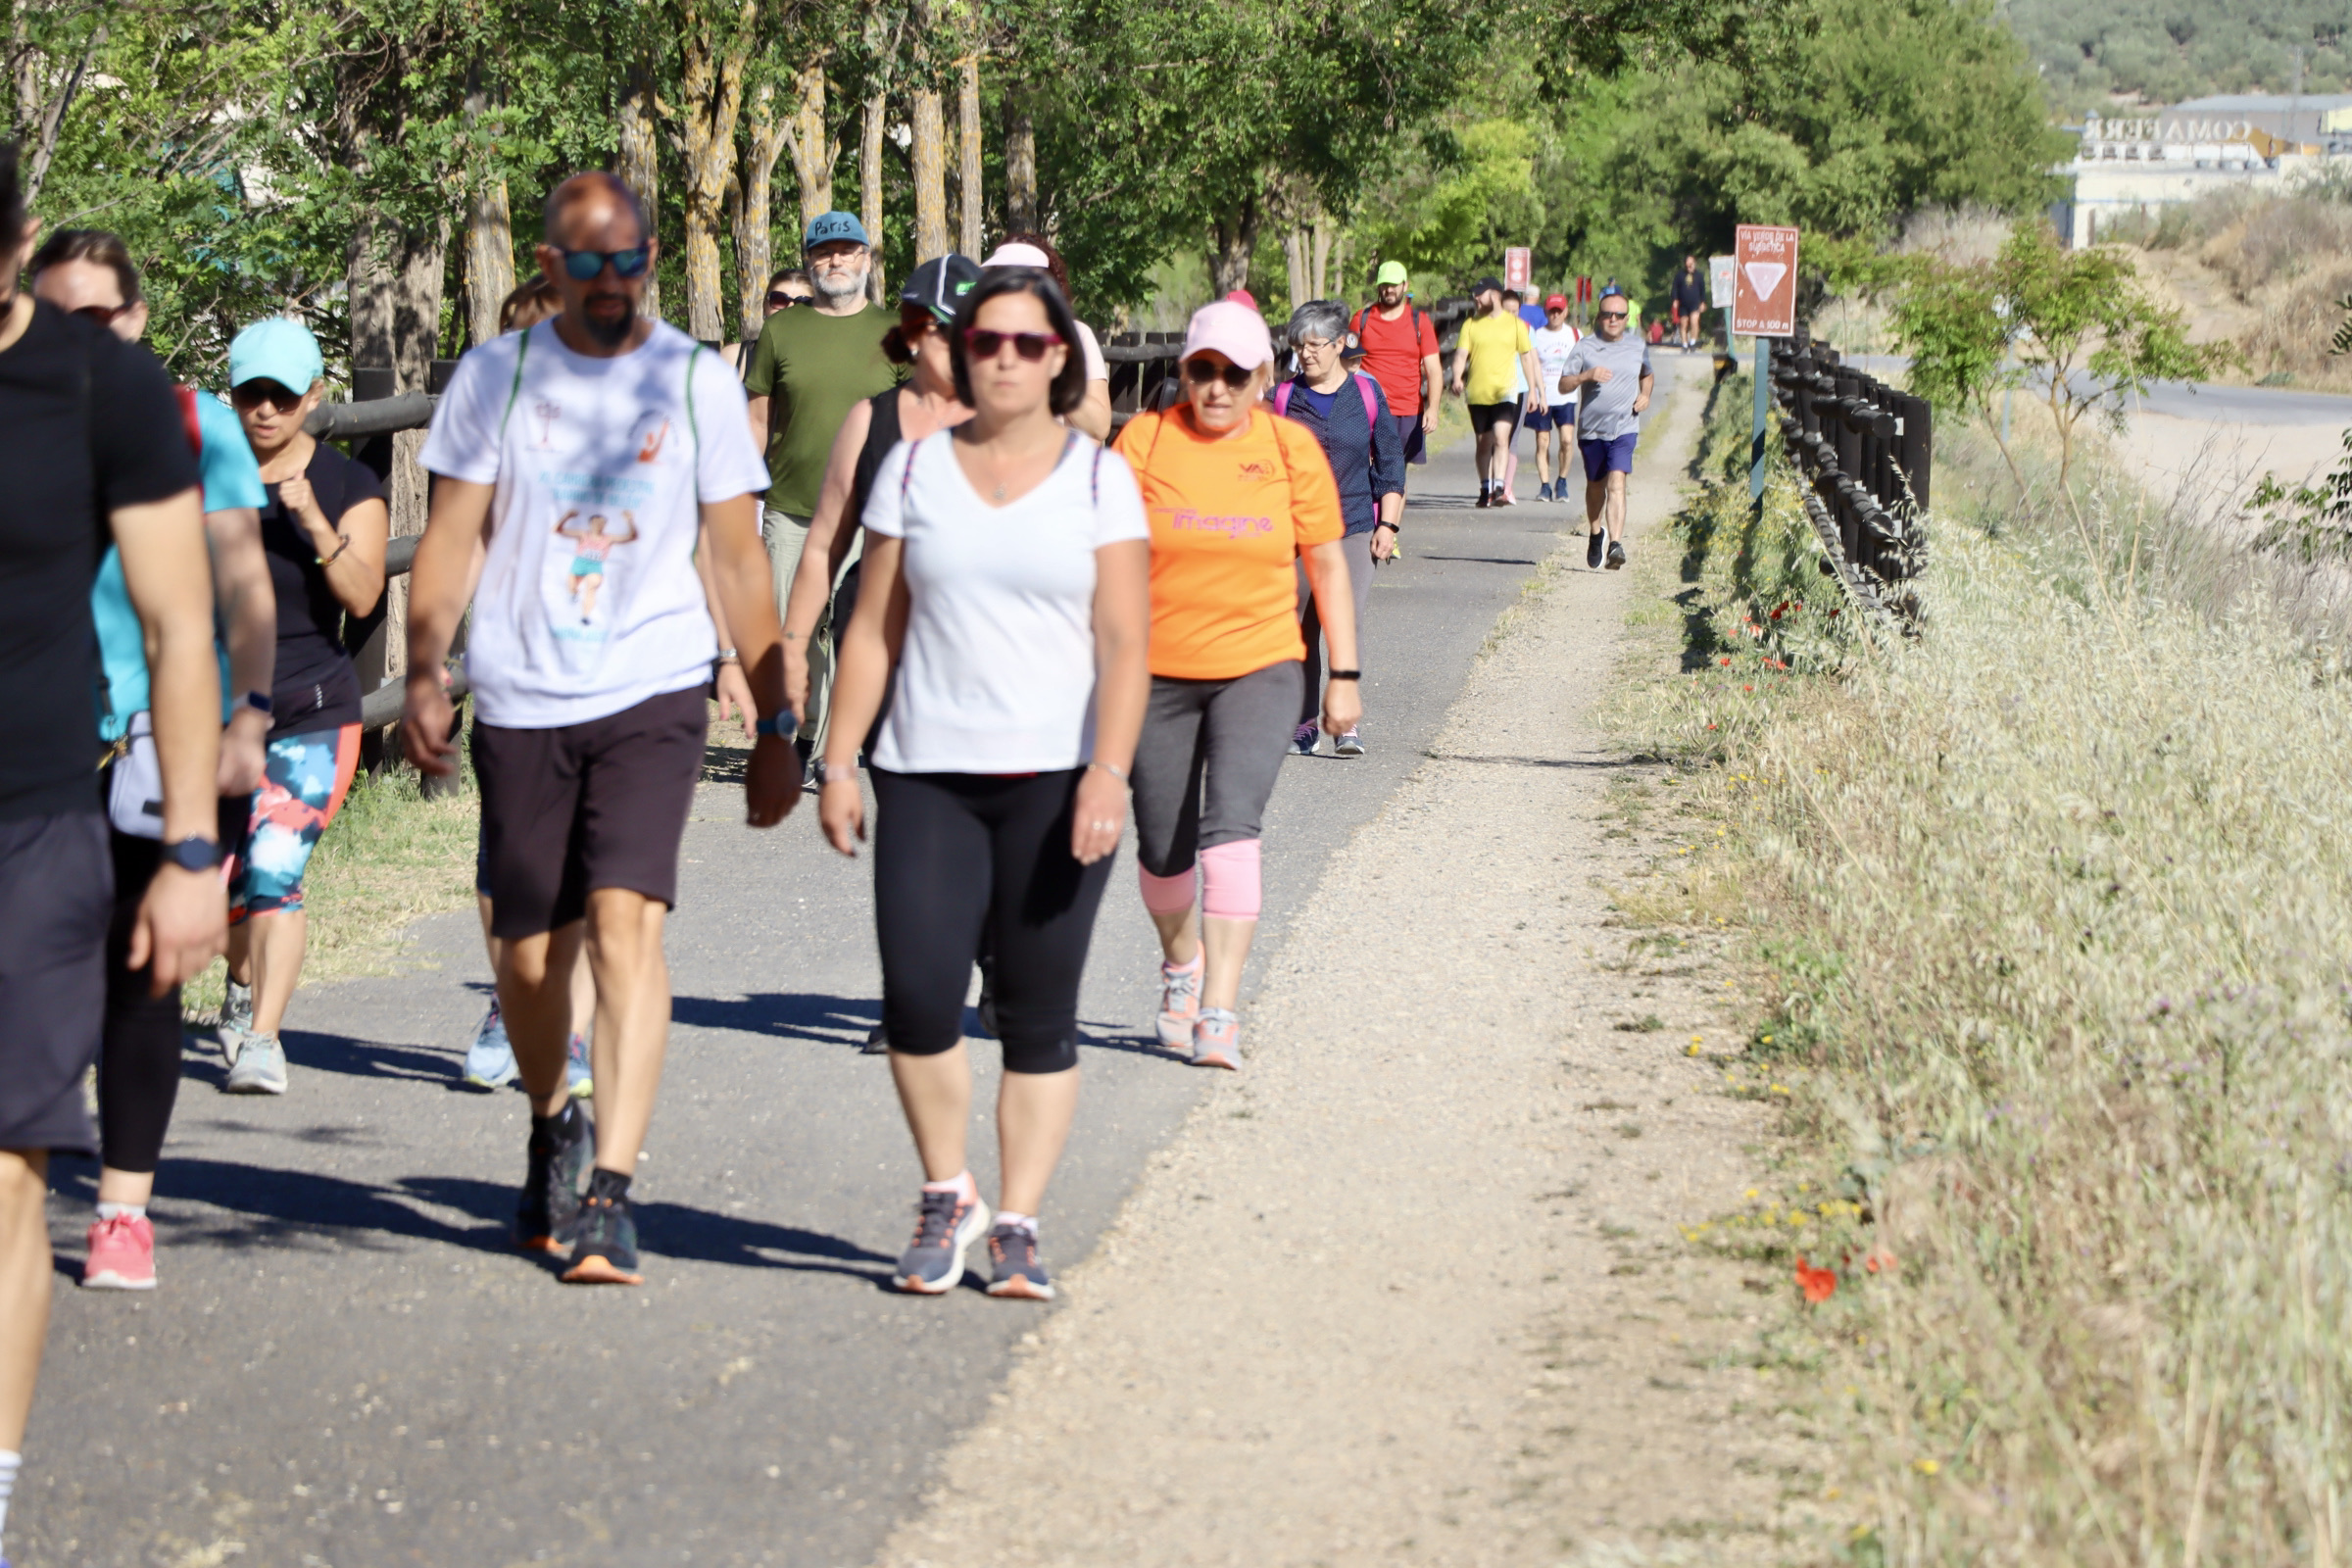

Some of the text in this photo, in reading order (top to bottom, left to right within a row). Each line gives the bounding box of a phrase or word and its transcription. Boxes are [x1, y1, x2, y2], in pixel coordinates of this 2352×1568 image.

[814, 220, 851, 236] Paris
[1753, 230, 1774, 242] VERDE
[1775, 231, 1785, 242] DE
[1786, 232, 1794, 242] LA
[1736, 318, 1757, 328] STOP
[1759, 319, 1765, 329] A
[1767, 319, 1781, 329] 100
